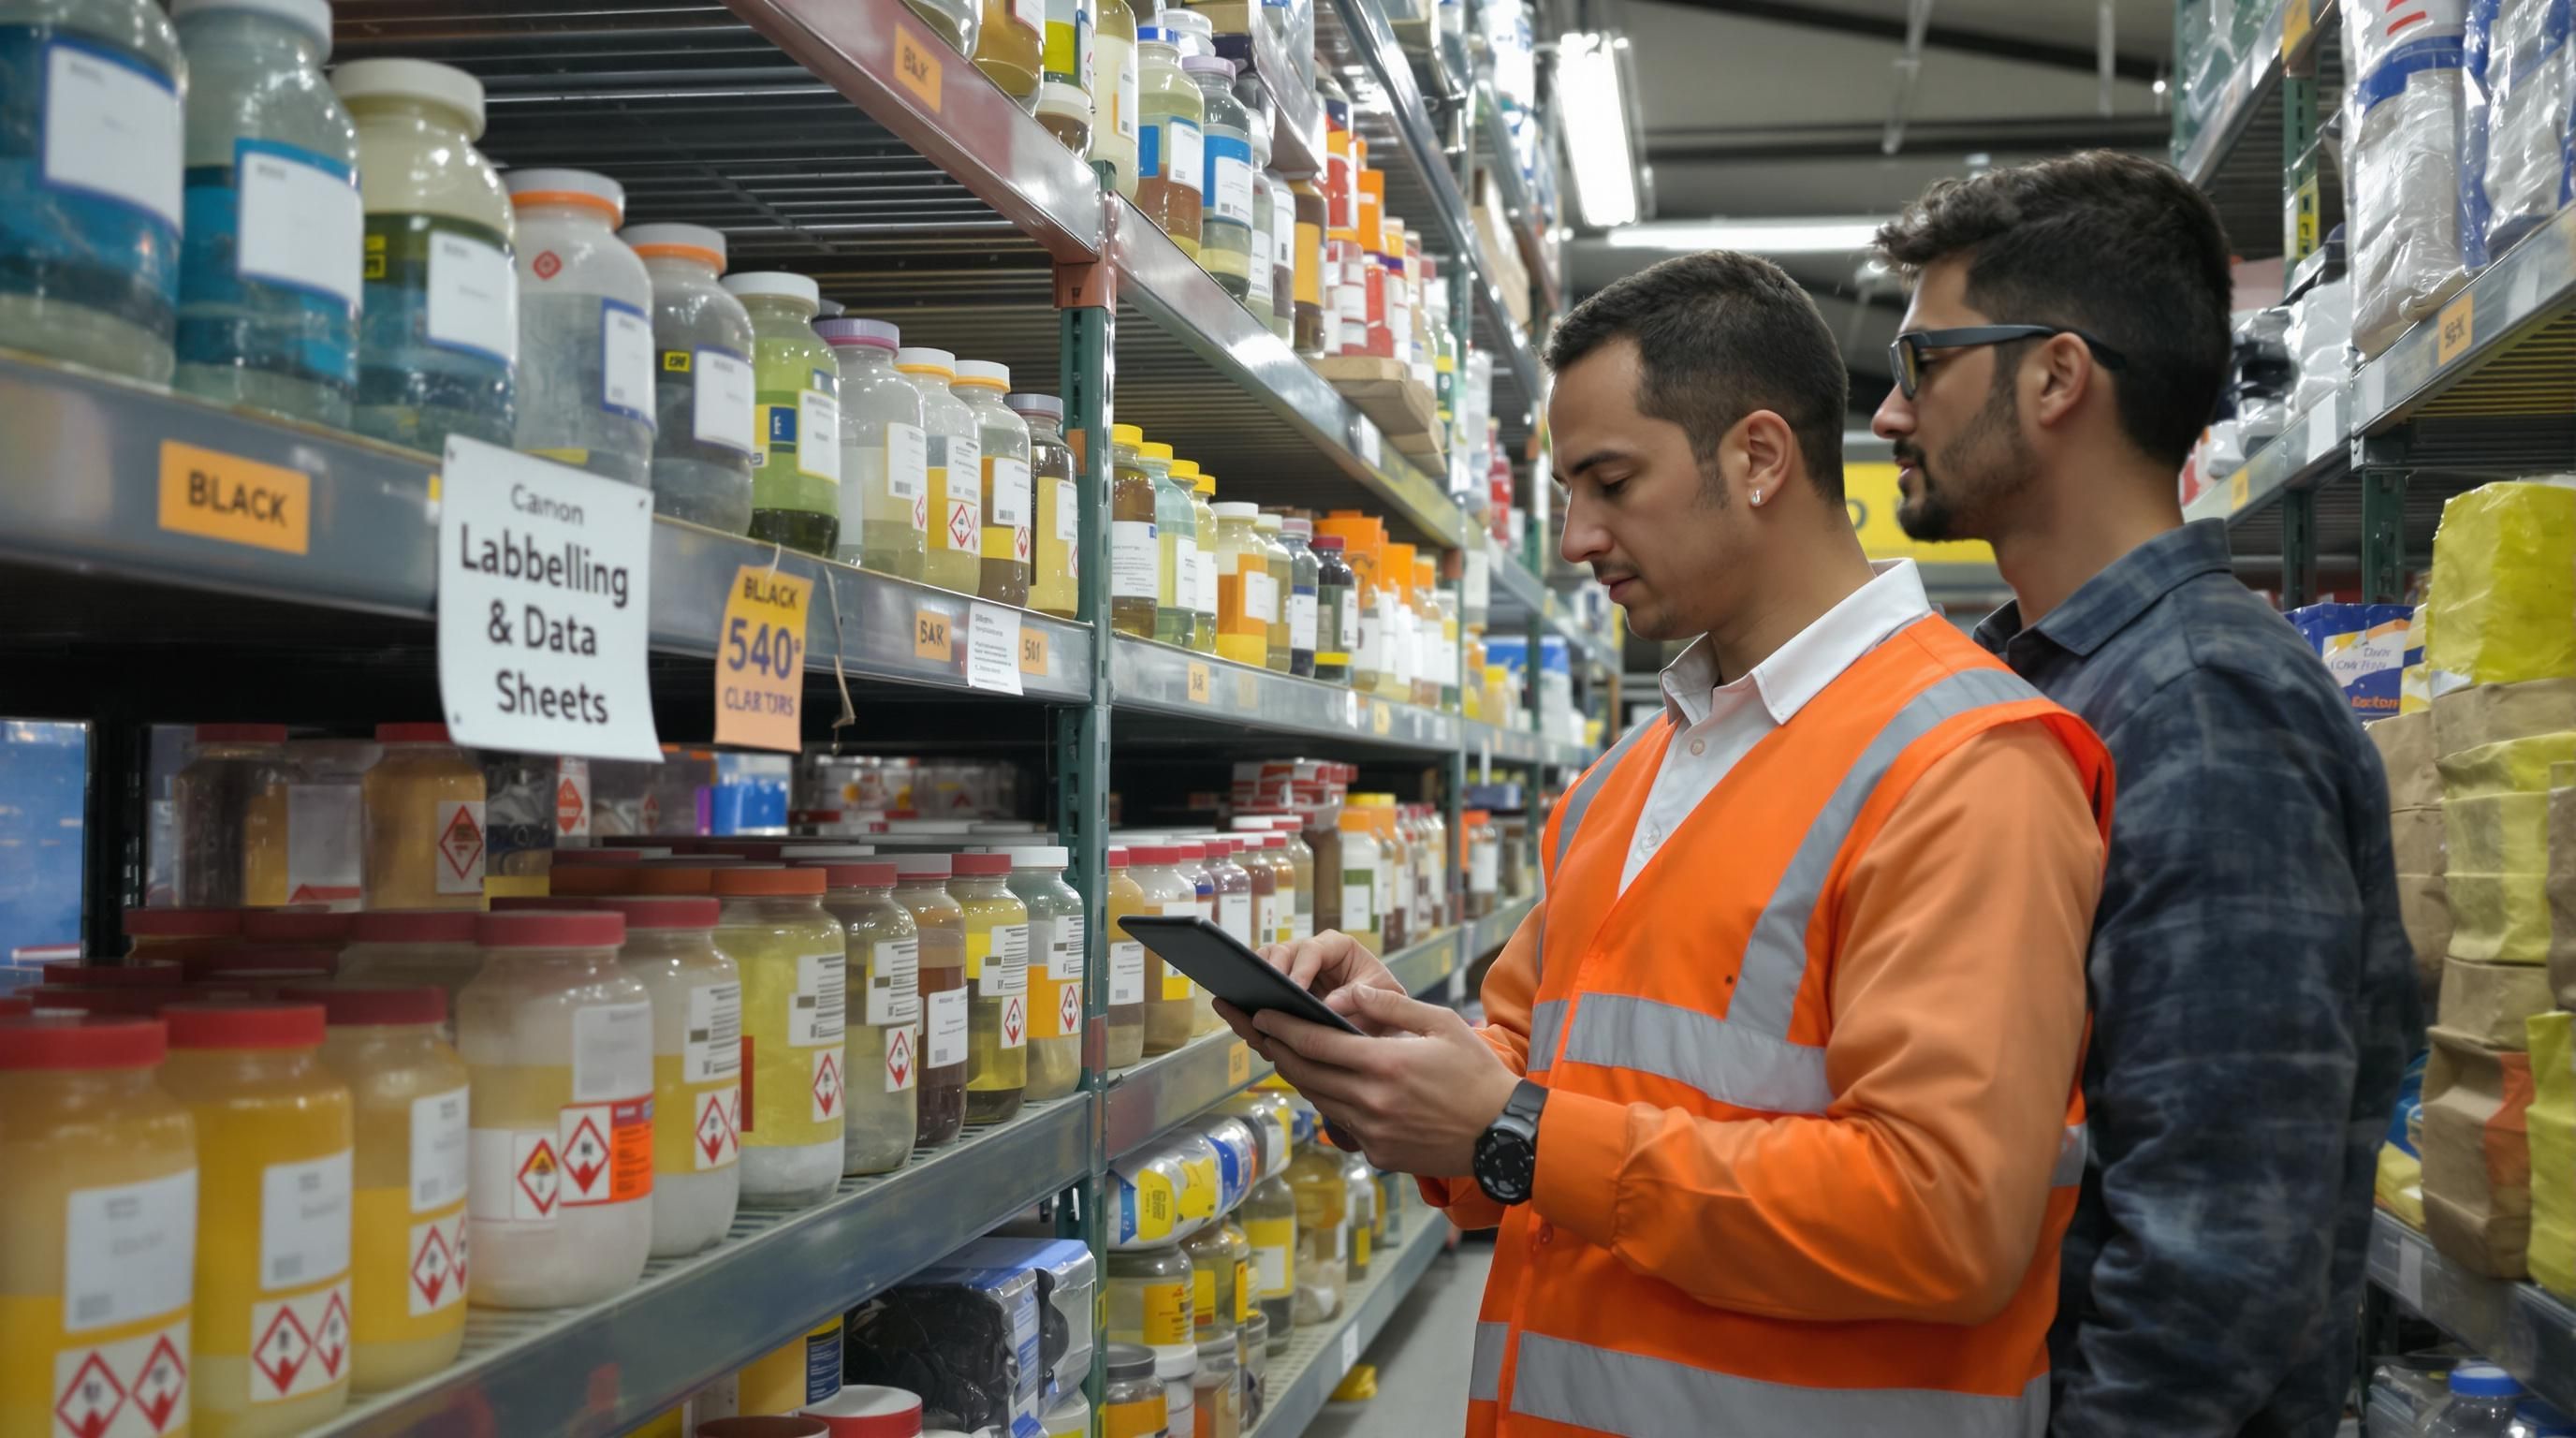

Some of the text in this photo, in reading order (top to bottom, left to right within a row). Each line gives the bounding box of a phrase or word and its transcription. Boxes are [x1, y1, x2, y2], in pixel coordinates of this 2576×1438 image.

[187, 469, 288, 530] BLACK
[461, 522, 628, 609] Labbelling
[743, 576, 798, 609] BLACK
[488, 598, 597, 656] & Data
[495, 668, 609, 725] Sheets
